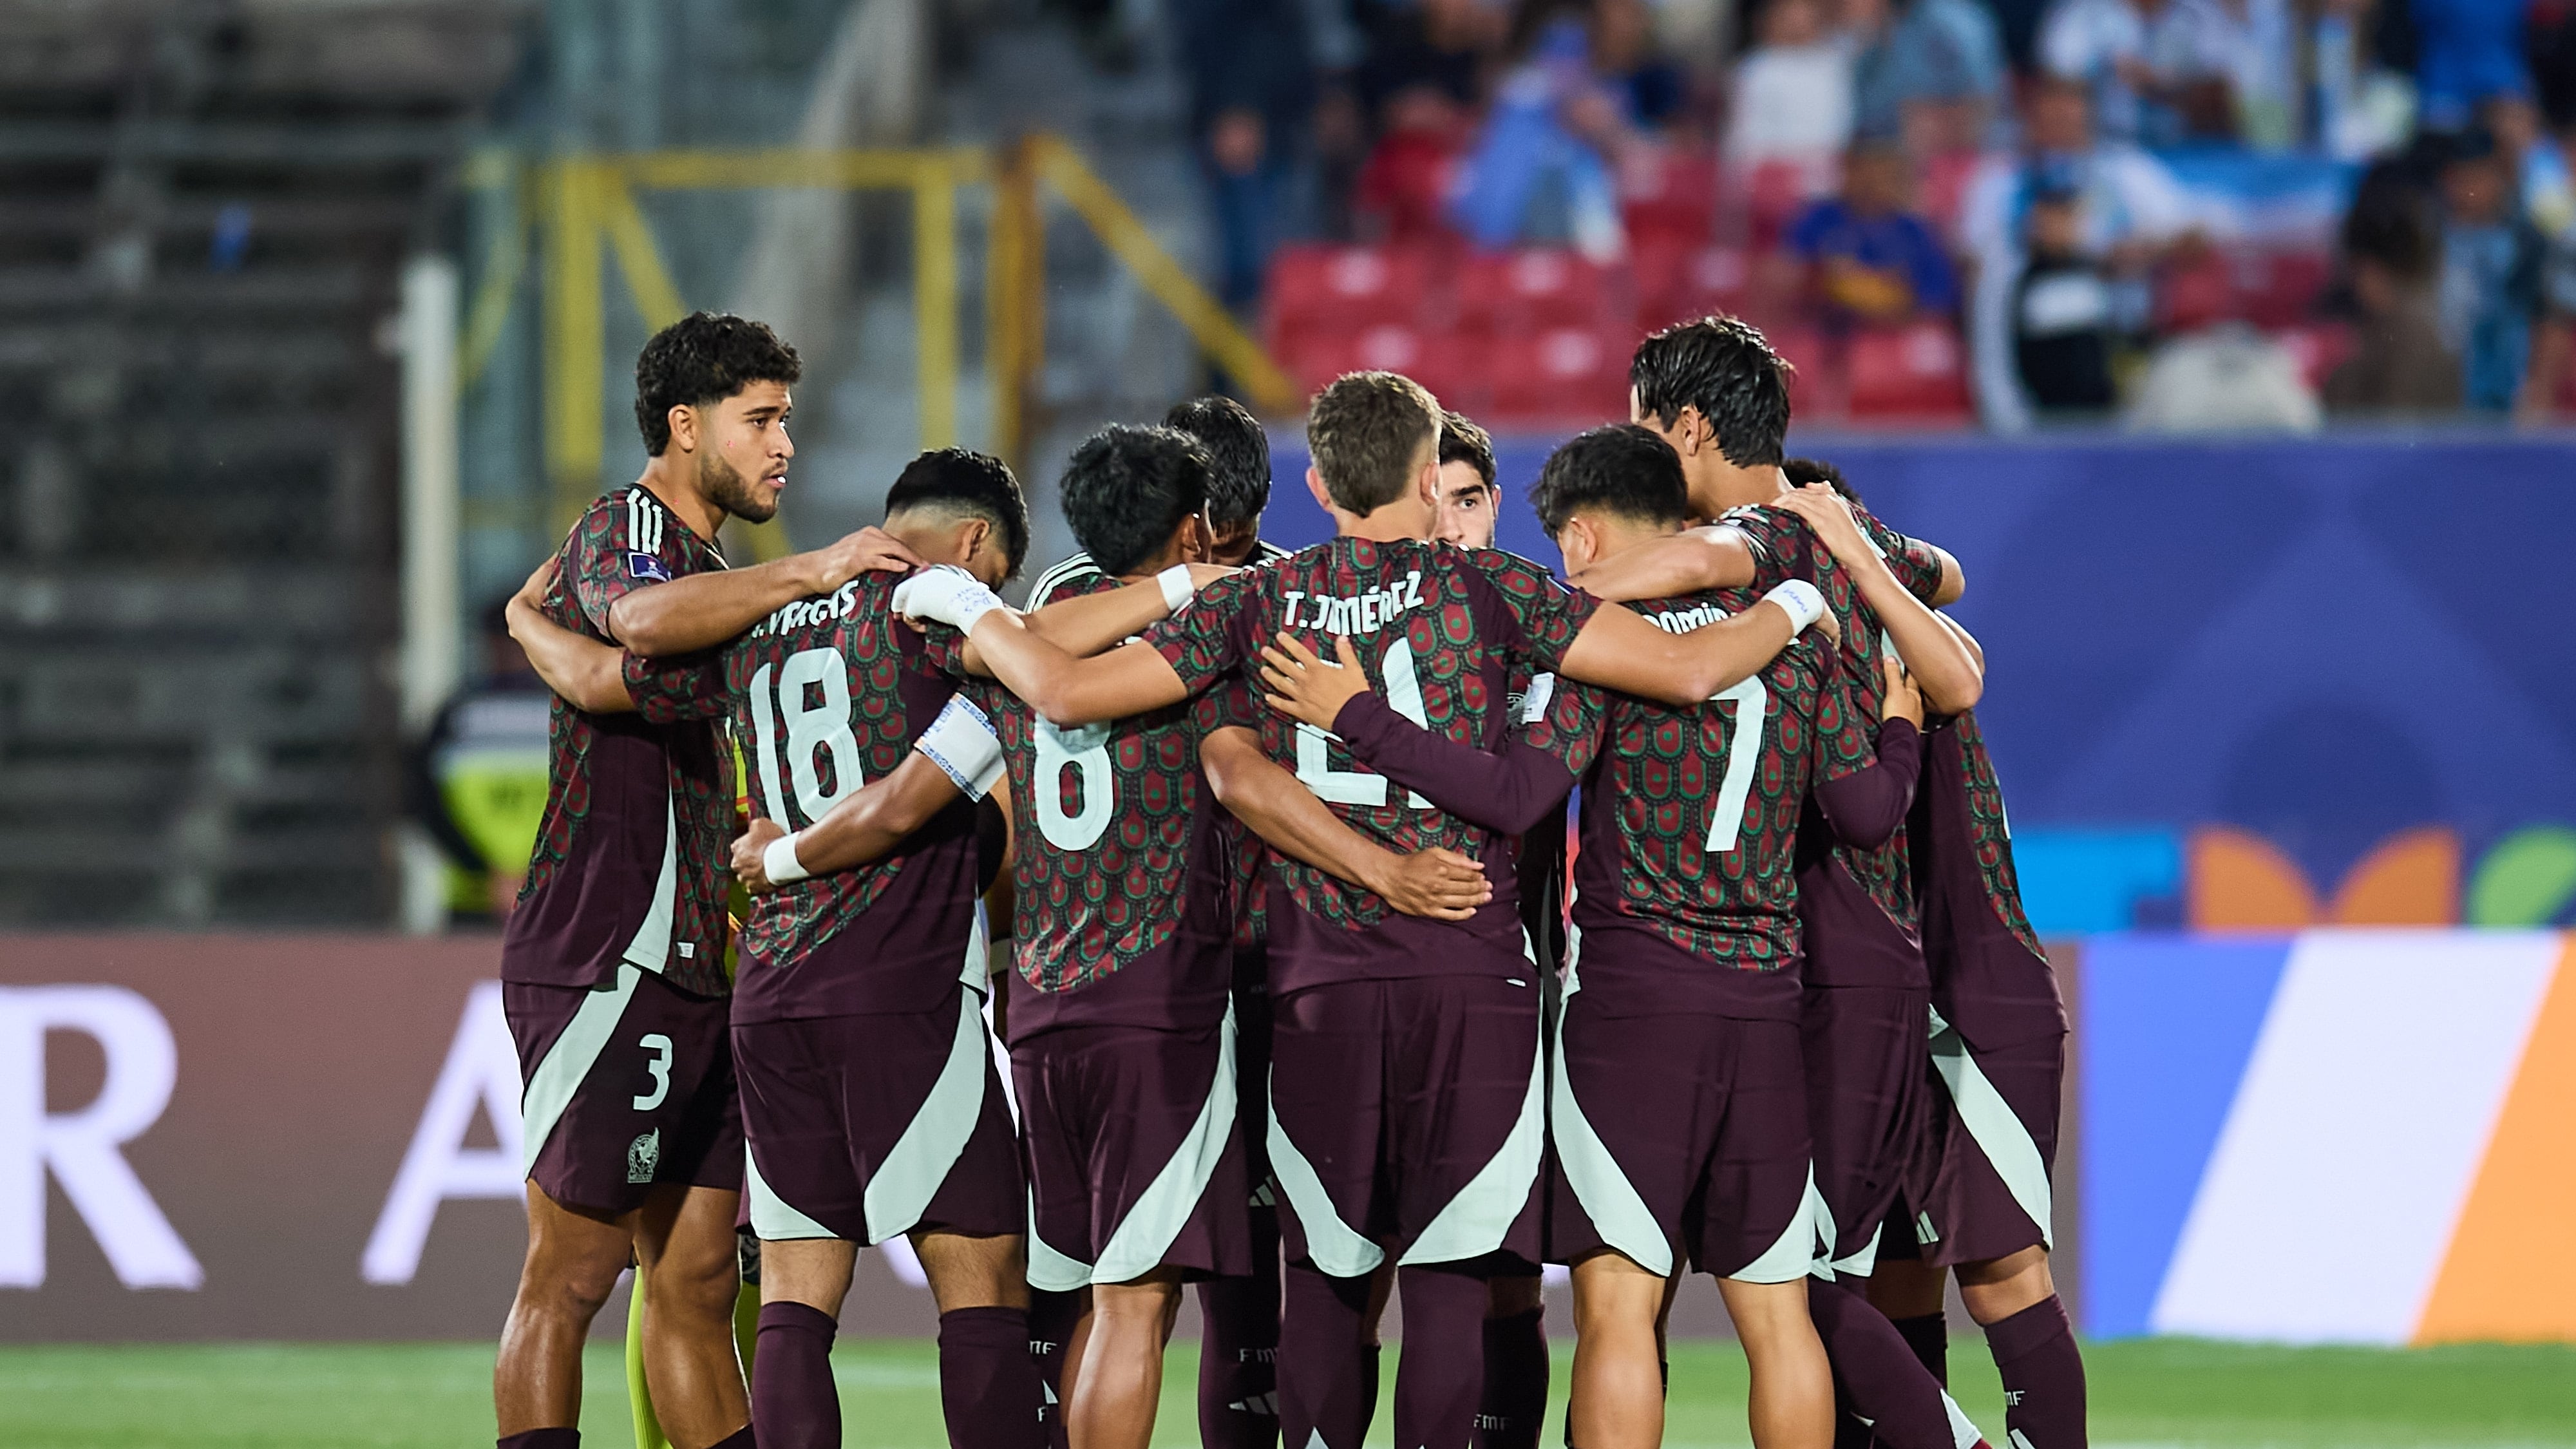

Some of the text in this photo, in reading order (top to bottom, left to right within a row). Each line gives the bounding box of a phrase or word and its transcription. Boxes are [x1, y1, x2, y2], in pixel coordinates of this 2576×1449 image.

[750, 647, 865, 835] 18
[1705, 674, 1767, 852] 7
[633, 1033, 673, 1111] 3
